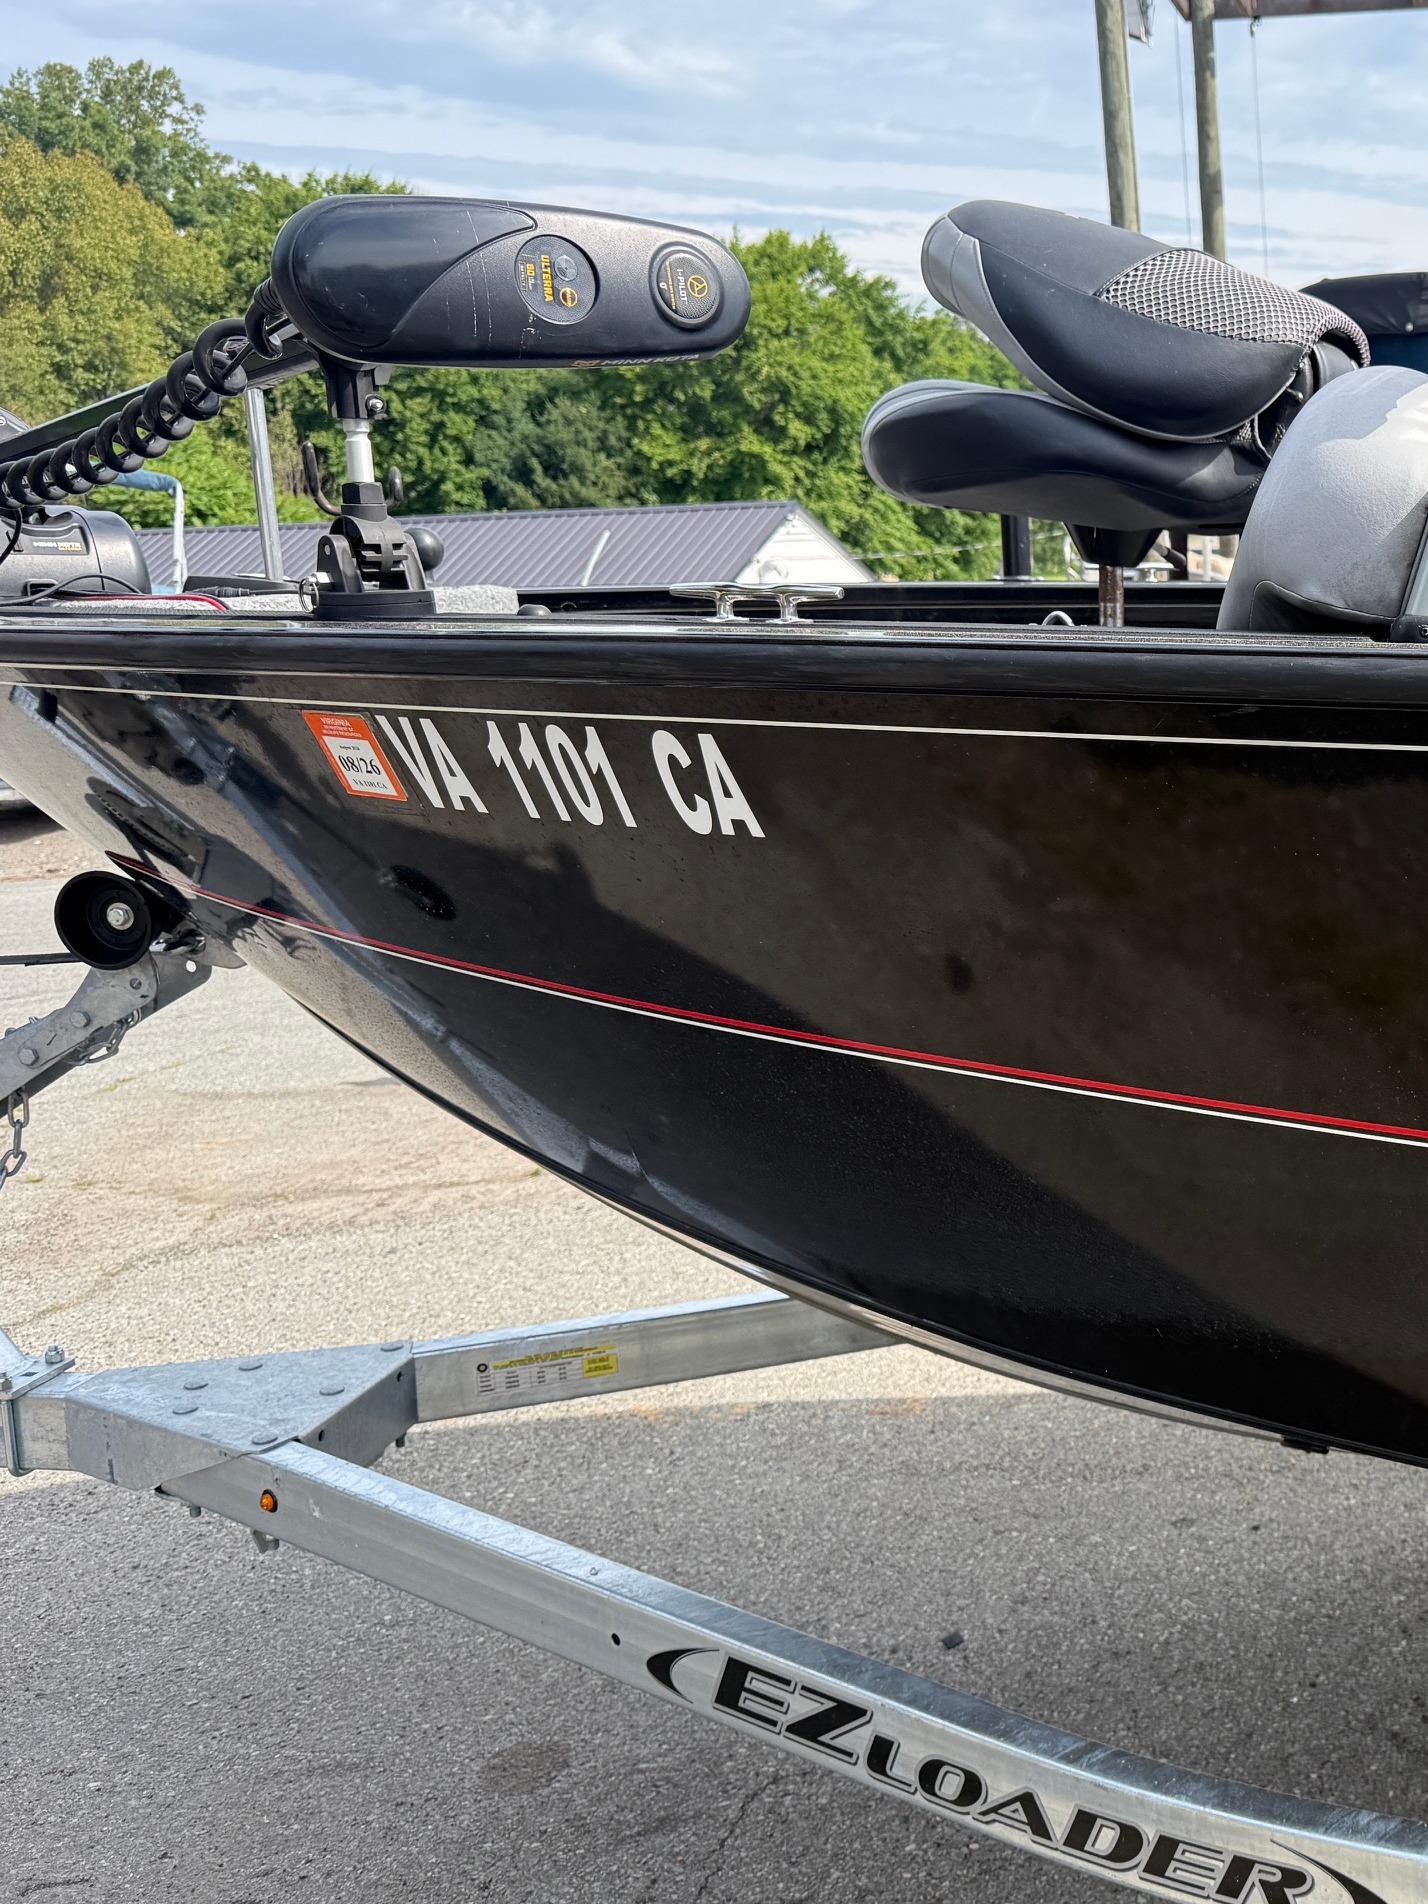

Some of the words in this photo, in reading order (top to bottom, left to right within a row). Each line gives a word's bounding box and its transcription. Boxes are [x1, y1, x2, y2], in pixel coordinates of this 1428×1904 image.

[541, 254, 553, 302] ULTERRA
[338, 754, 381, 776] 08/26
[375, 714, 488, 813] VA
[487, 720, 638, 829] 1101
[651, 729, 767, 839] CA
